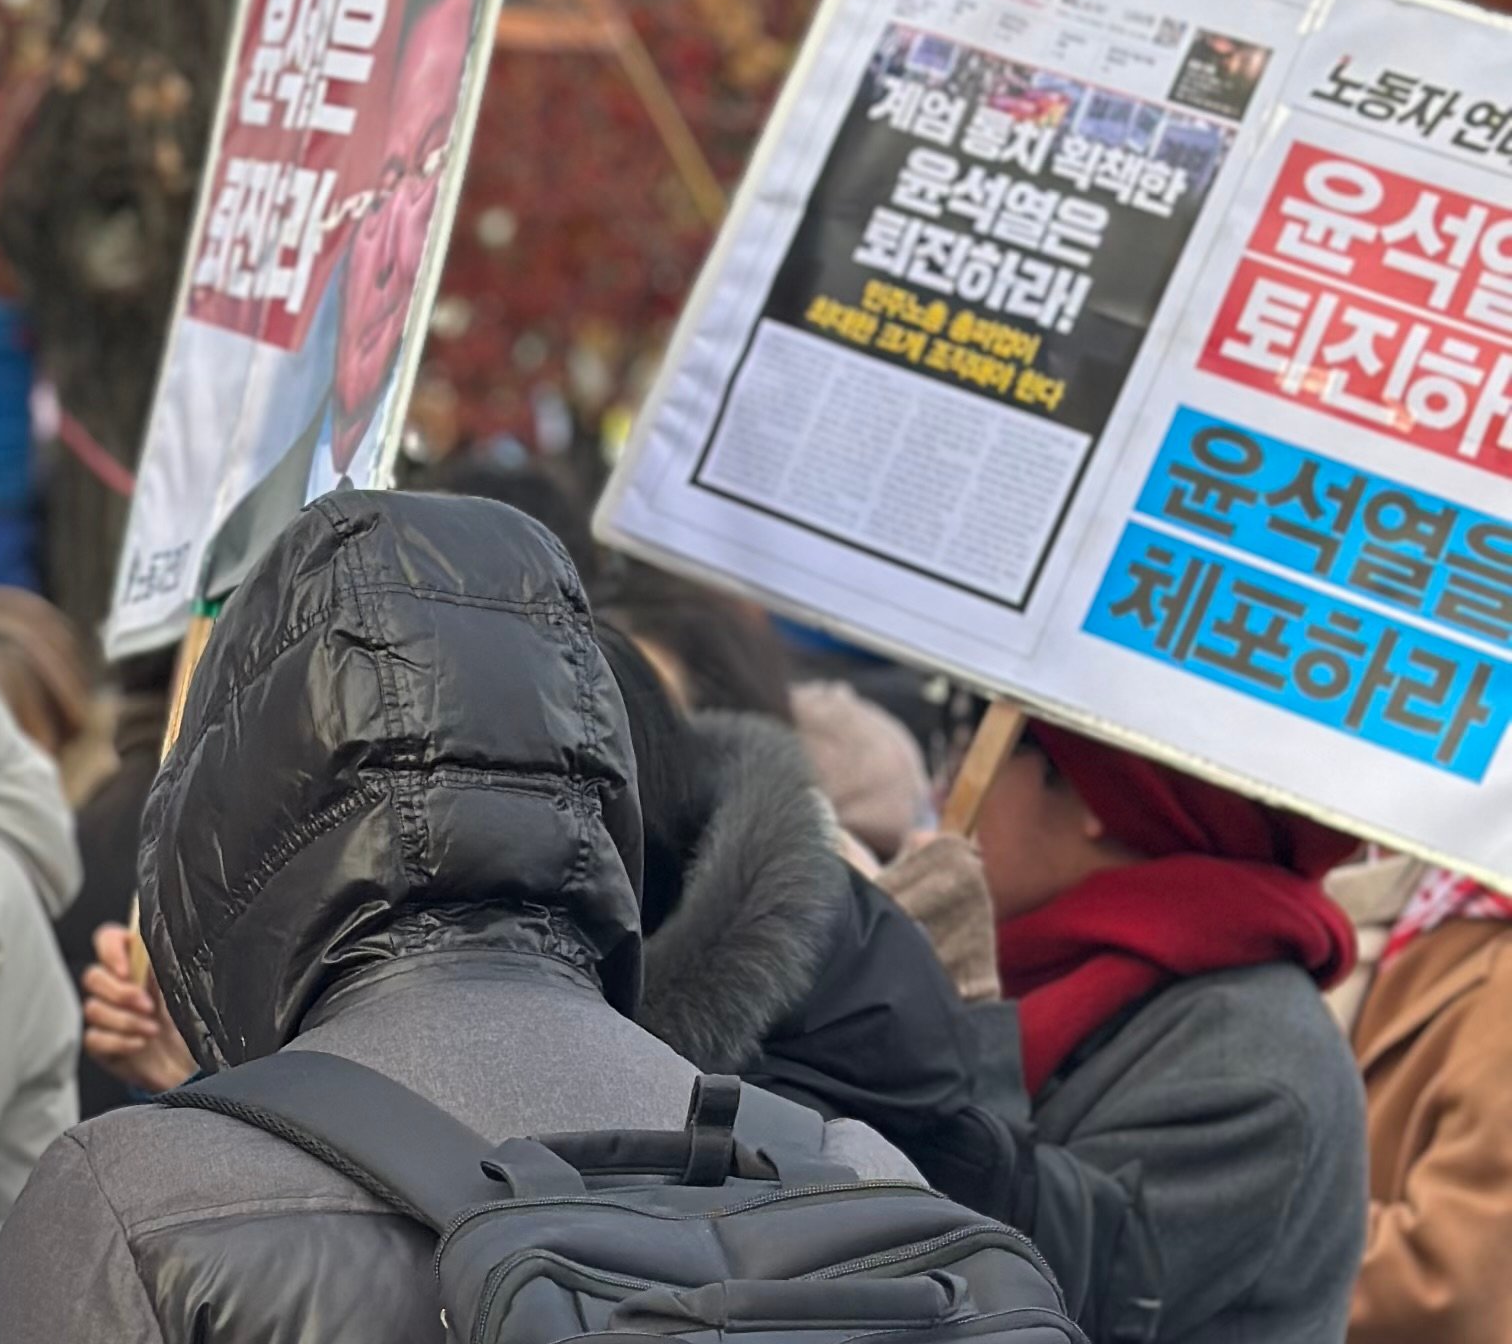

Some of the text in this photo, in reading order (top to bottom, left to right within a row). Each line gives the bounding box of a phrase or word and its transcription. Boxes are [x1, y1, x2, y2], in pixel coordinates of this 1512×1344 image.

[867, 76, 966, 147] 계엄
[1052, 132, 1188, 218] 획책한
[1311, 55, 1461, 140] 노동자
[852, 205, 1094, 334] 퇴진하라!
[890, 146, 1109, 267] 윤석열은
[1219, 276, 1512, 458] 퇴진하
[1109, 542, 1493, 765] 체포하라
